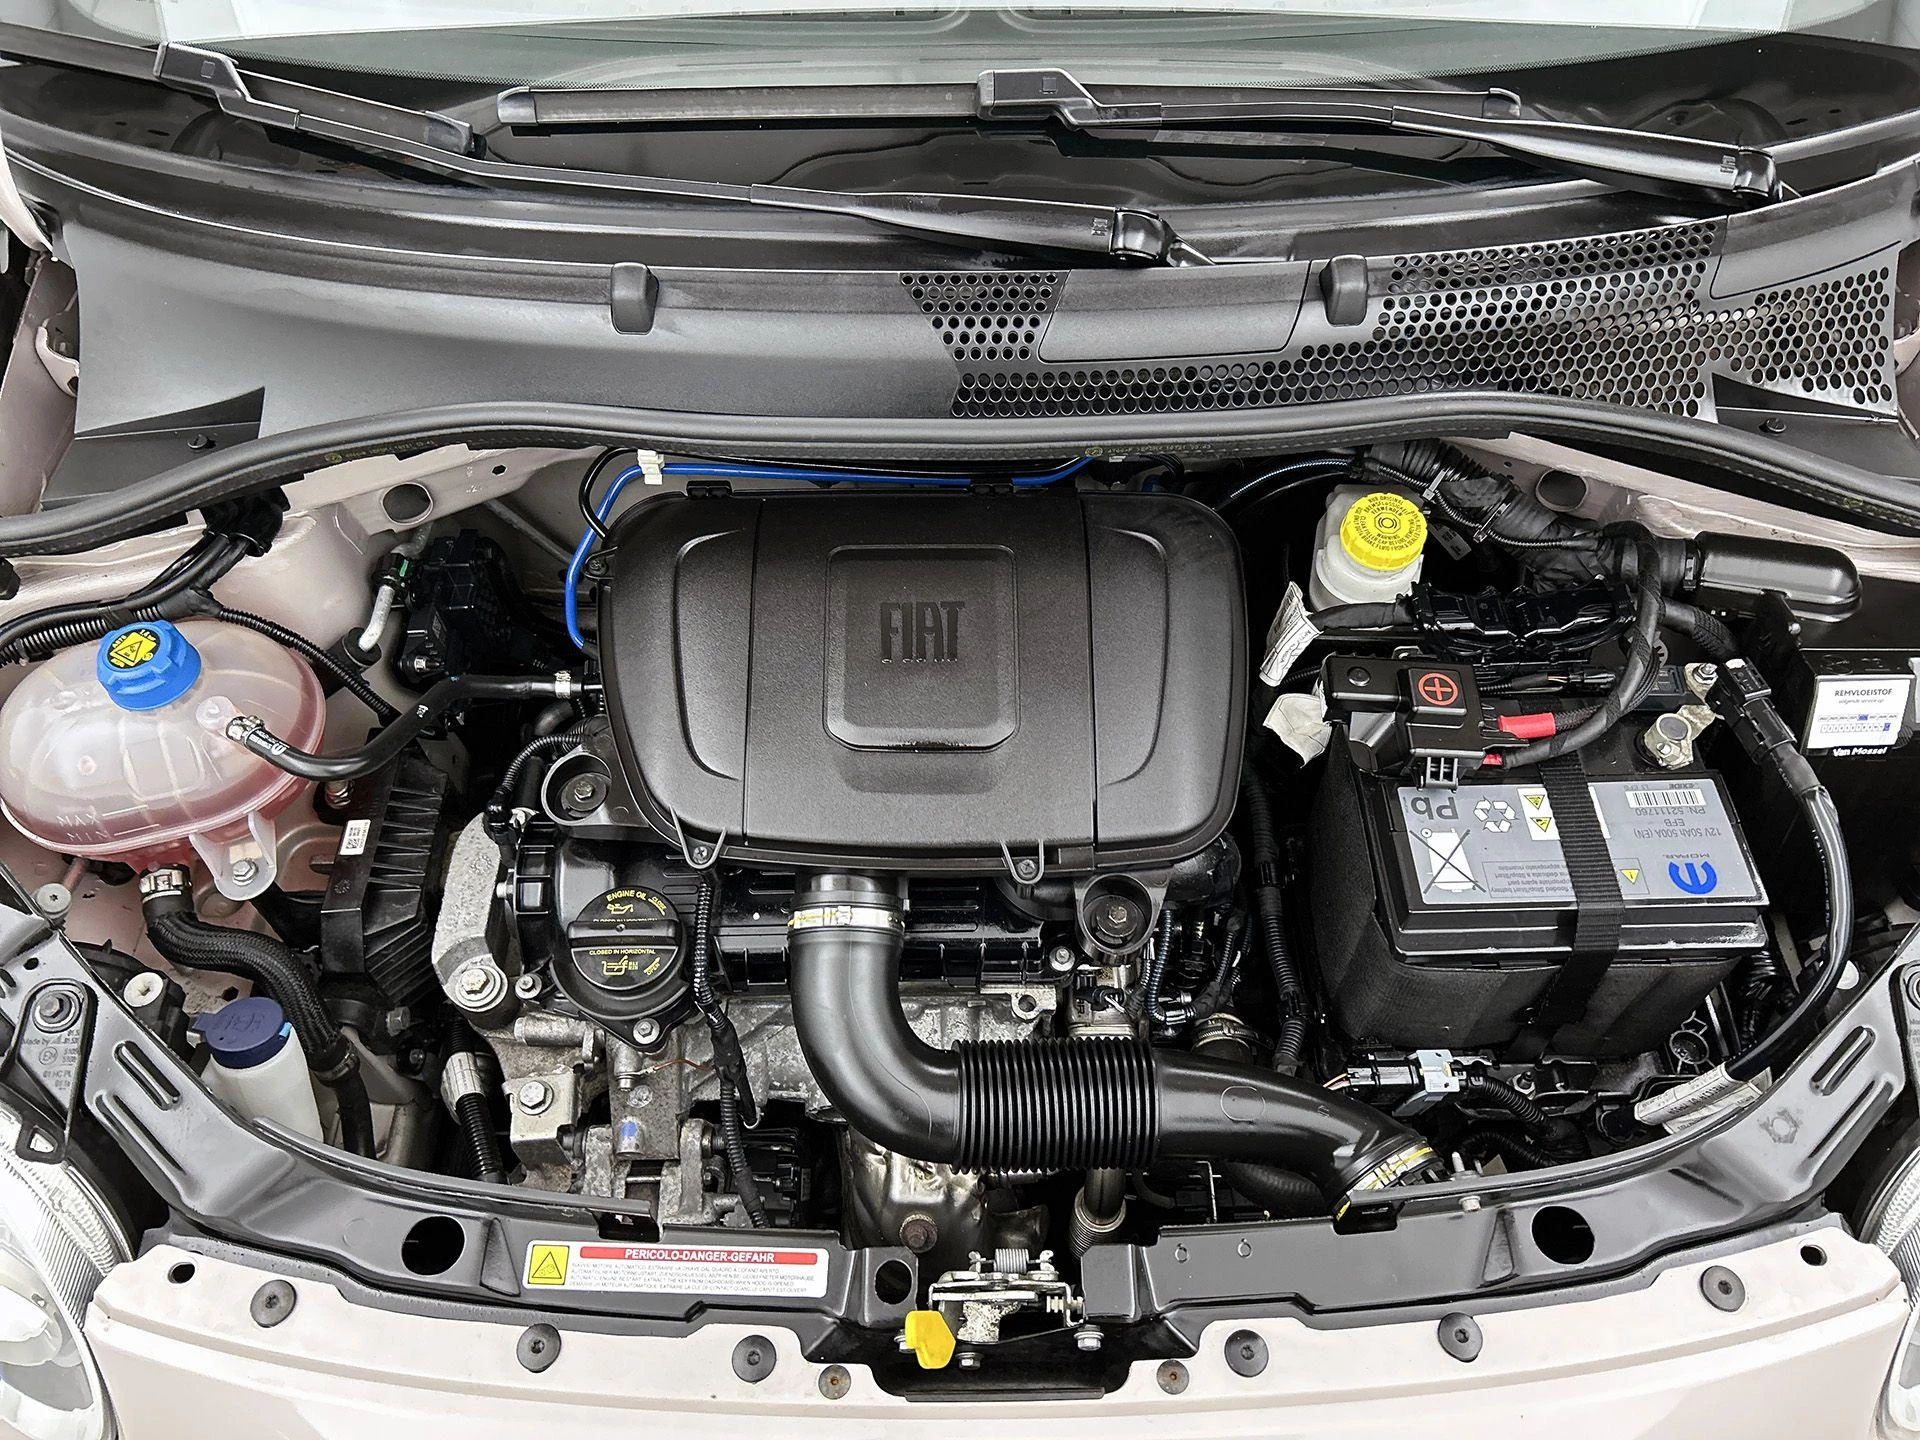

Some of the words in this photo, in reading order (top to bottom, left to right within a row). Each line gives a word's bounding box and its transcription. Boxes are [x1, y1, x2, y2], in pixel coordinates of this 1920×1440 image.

[881, 601, 965, 663] FIAT
[1834, 688, 1893, 697] REMVLOEISTOF
[1832, 748, 1850, 757] Van
[1851, 746, 1888, 756] Mossel
[1410, 796, 1459, 820] Pb
[1635, 807, 1684, 816] 52111760
[1687, 806, 1706, 815] PN:
[1664, 818, 1685, 827] EFB
[1633, 828, 1652, 839] (EN)
[1654, 828, 1677, 839] 500A
[1678, 828, 1702, 838] 50Ah
[1705, 828, 1722, 837] 12V
[606, 889, 636, 902] ENGINE
[636, 891, 647, 901] OIL
[624, 1248, 775, 1263] PERICOLO-DANGER-GEFAHR
